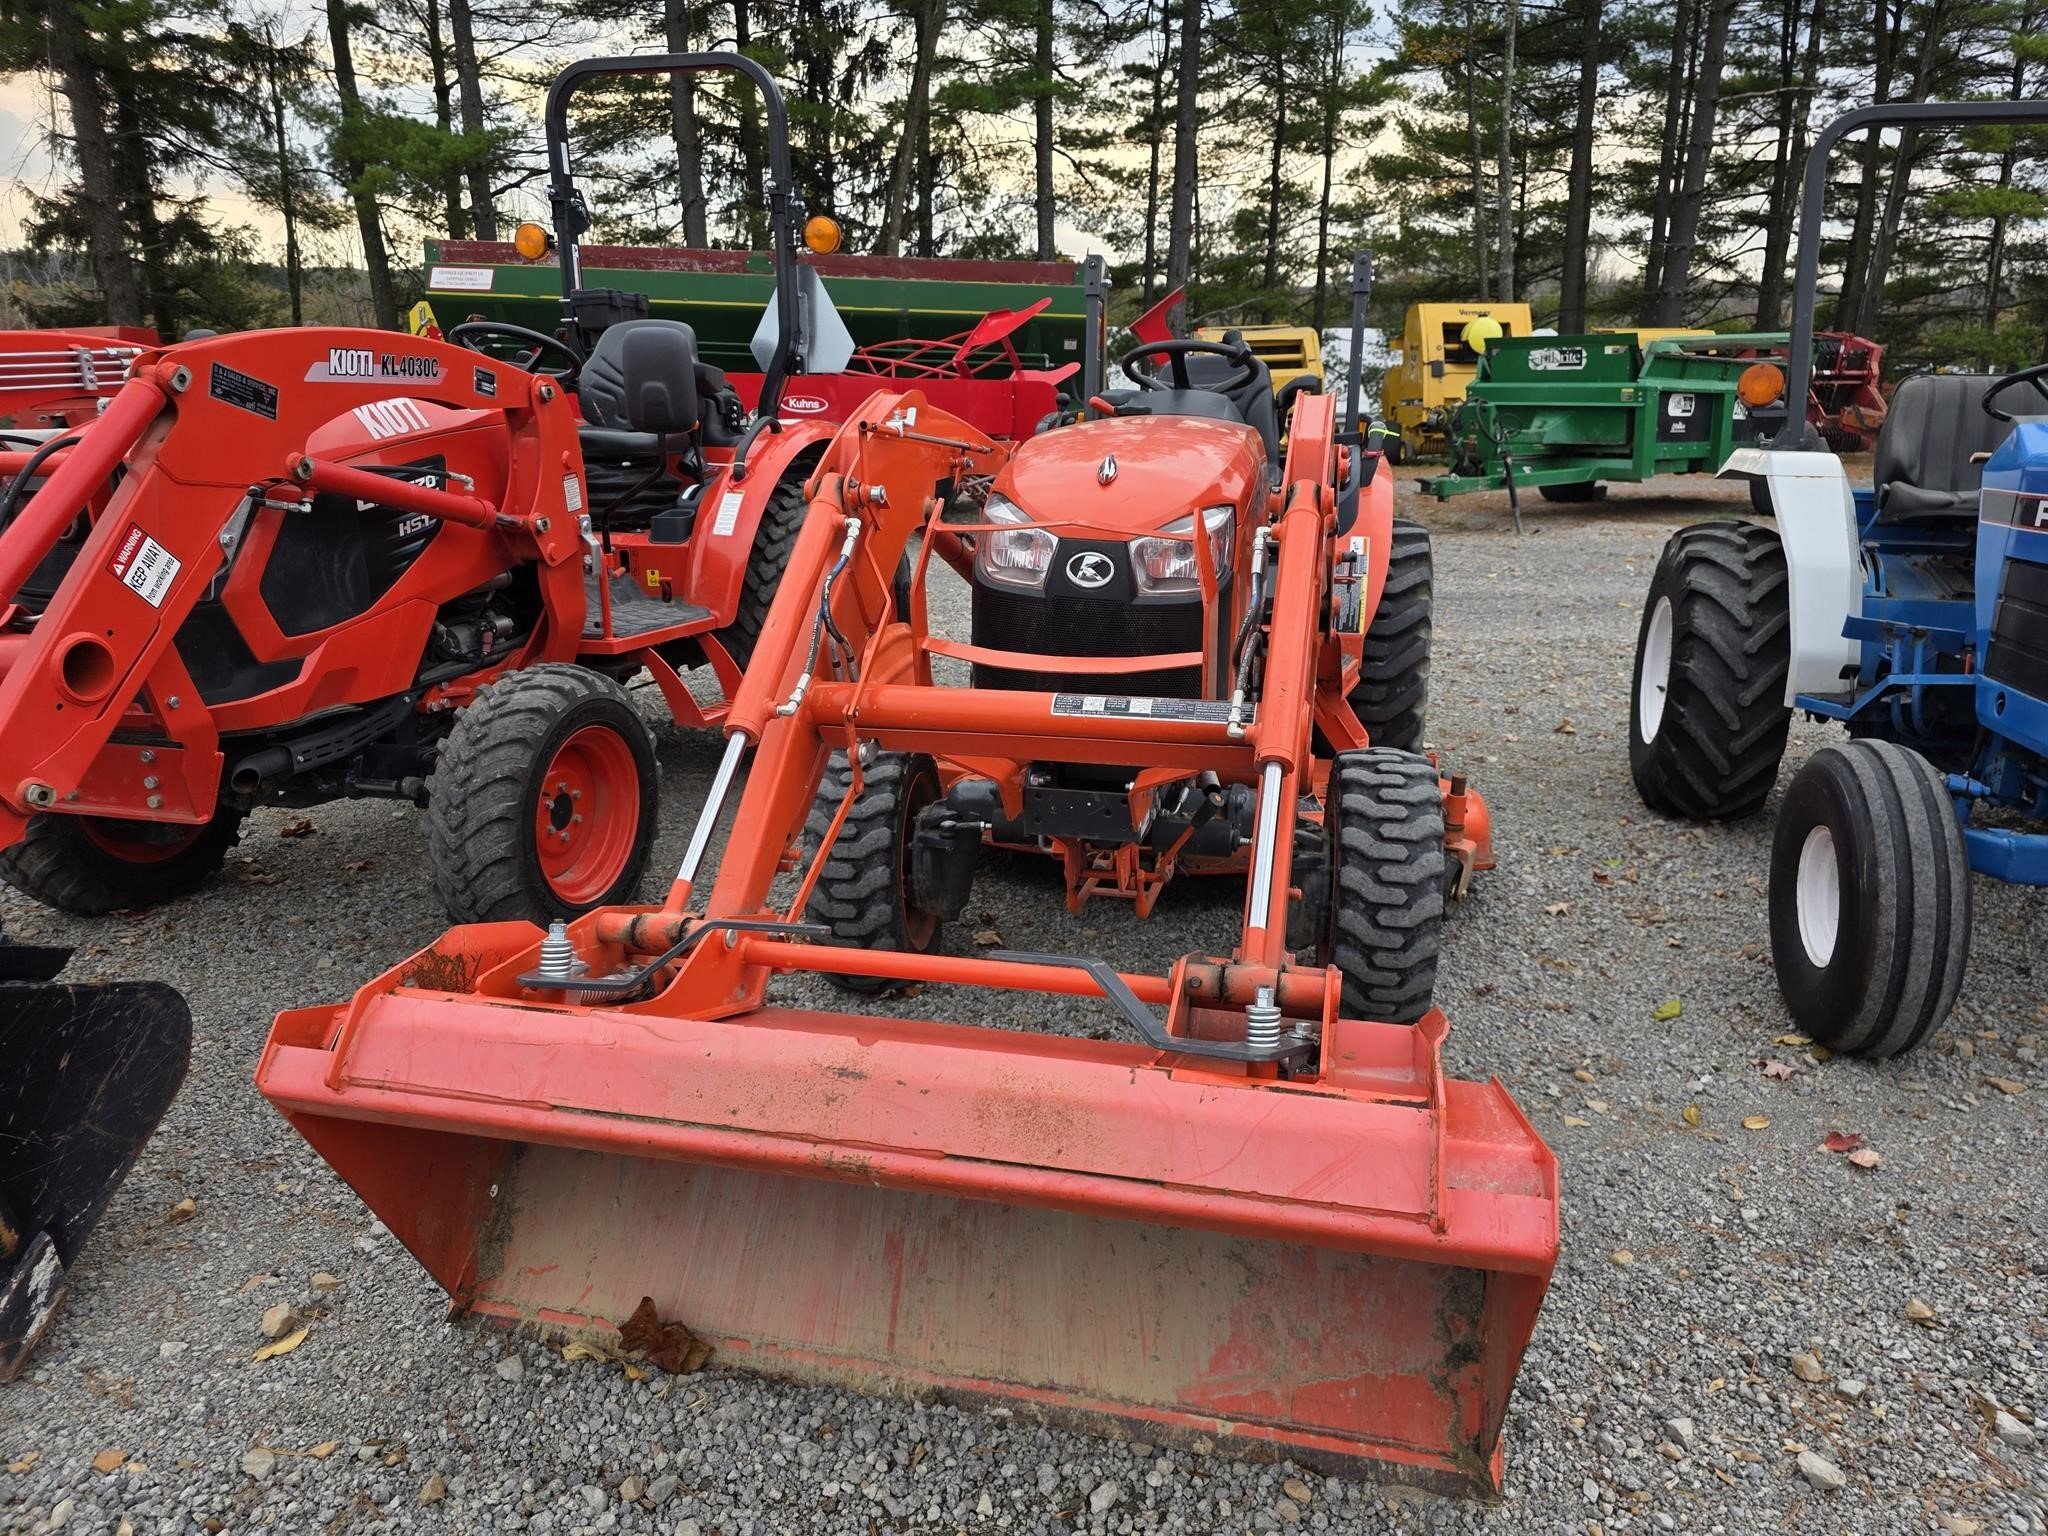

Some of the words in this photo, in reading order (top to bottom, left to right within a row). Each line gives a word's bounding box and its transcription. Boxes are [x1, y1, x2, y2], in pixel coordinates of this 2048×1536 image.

[329, 349, 374, 376] KIOTI
[381, 354, 439, 378] KL4030C
[352, 397, 431, 441] KIOTI
[788, 398, 820, 409] Kuhns
[399, 514, 430, 537] HST
[117, 528, 143, 564] WARNING
[129, 566, 148, 592] KEEP
[141, 542, 161, 571] AWAY
[145, 587, 158, 601] from
[154, 567, 170, 590] working
[164, 556, 175, 570] area
